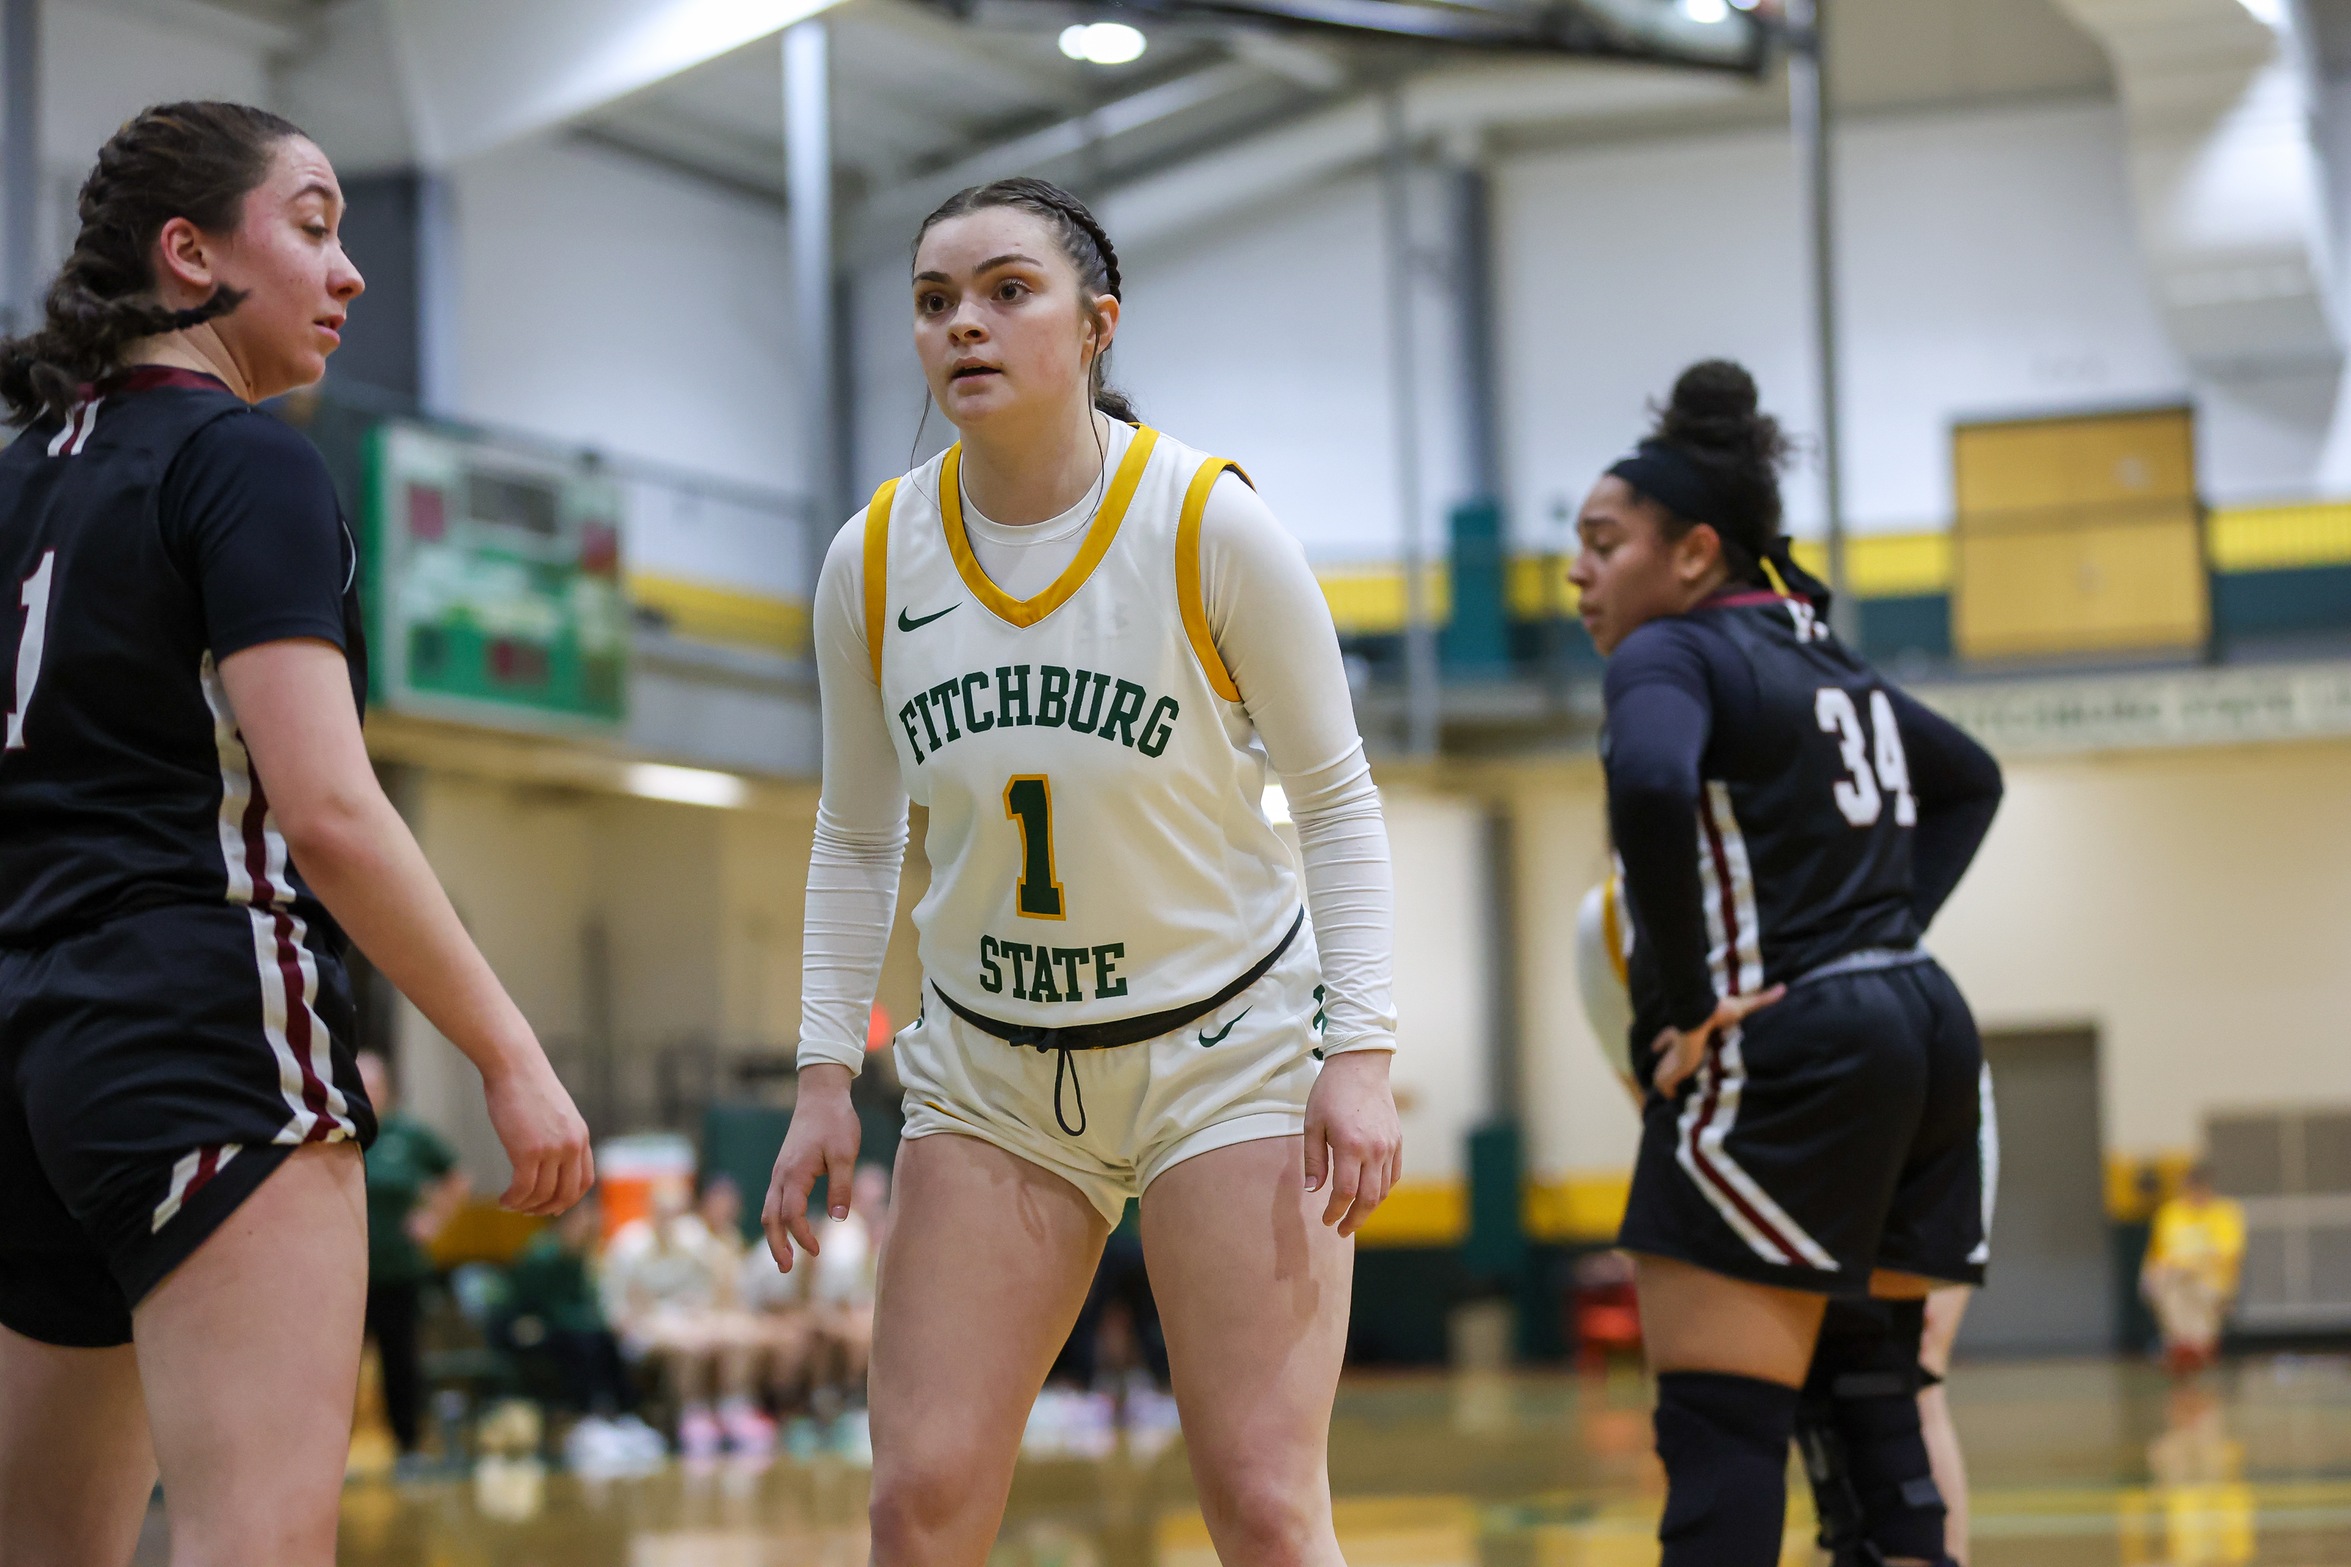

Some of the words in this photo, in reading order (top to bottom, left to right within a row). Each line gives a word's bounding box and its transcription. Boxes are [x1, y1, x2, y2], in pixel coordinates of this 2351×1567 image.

[6, 549, 55, 749] 1
[899, 664, 1180, 766] FITCHBURG
[1814, 686, 1918, 827] 34
[1002, 773, 1067, 921] 1
[979, 934, 1128, 1003] STATE
